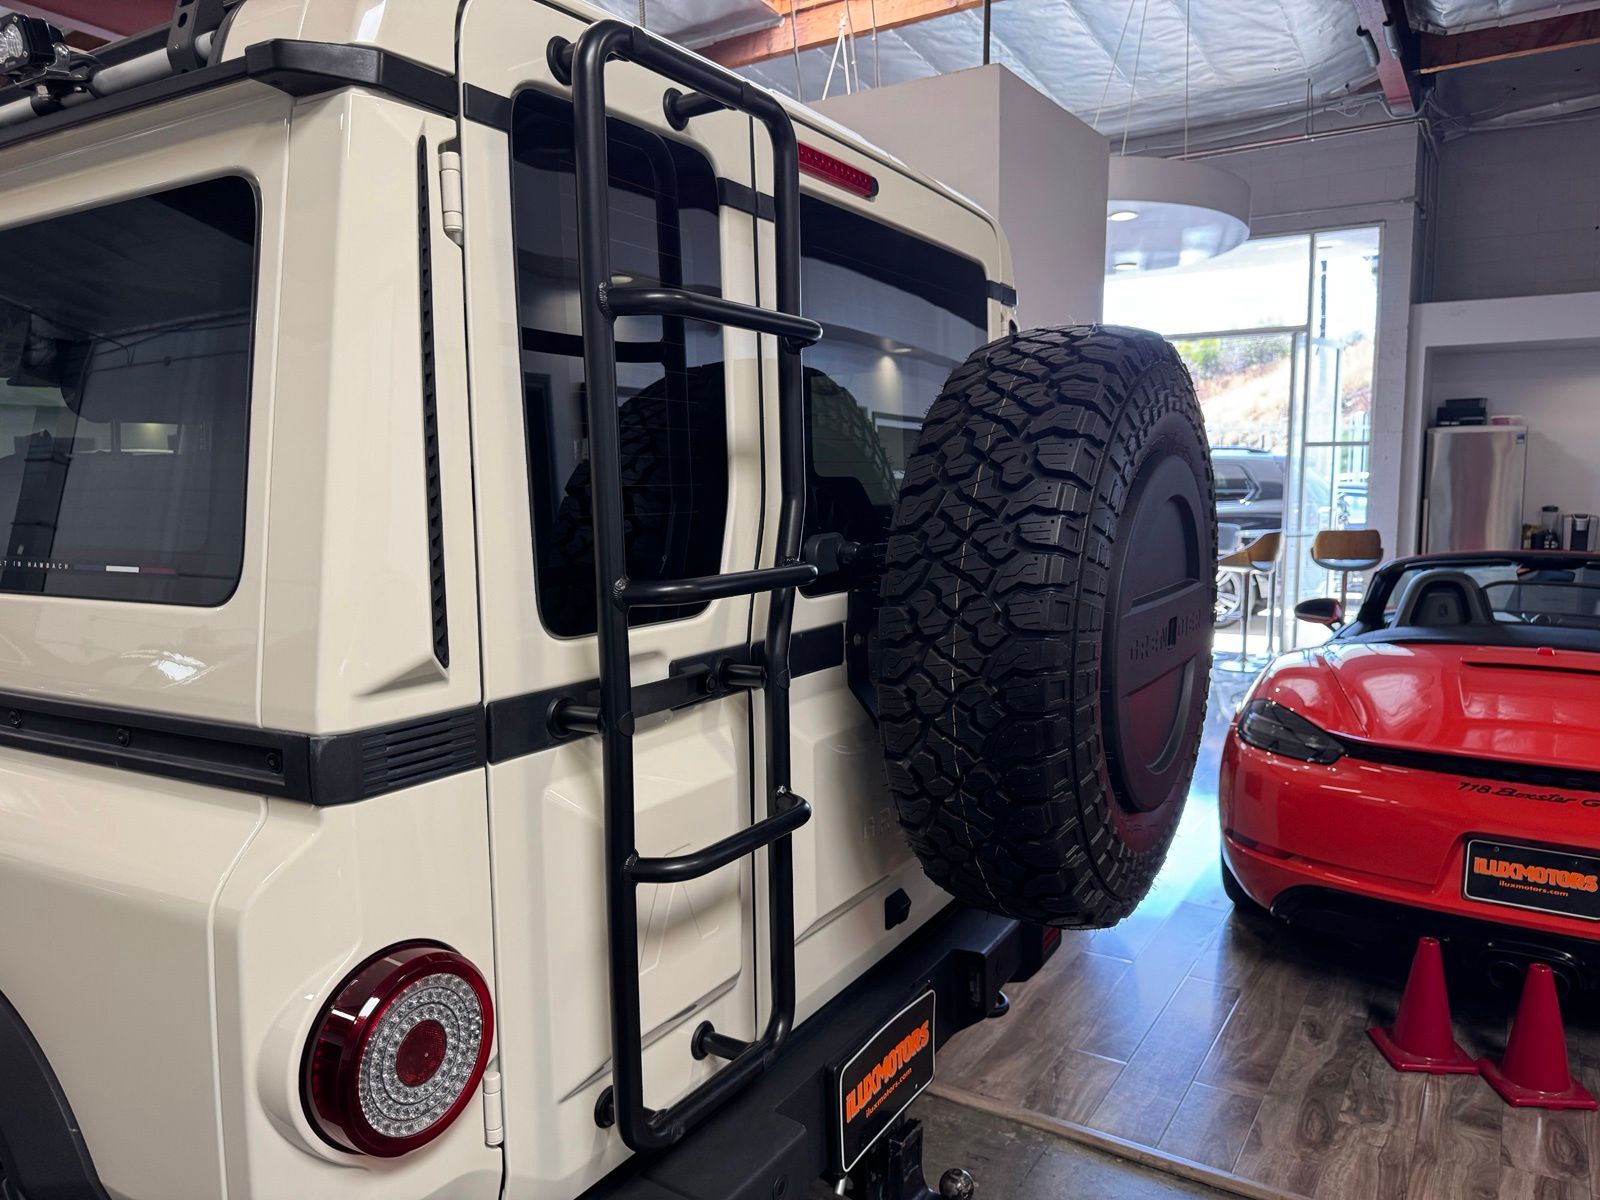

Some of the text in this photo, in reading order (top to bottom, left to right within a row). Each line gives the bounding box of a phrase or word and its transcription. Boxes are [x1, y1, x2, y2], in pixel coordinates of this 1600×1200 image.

[1458, 782, 1490, 794] 718
[1491, 786, 1575, 803] Boxster
[1499, 880, 1569, 897] iluxmotors.com
[866, 1068, 912, 1119] iluxmotors.com
